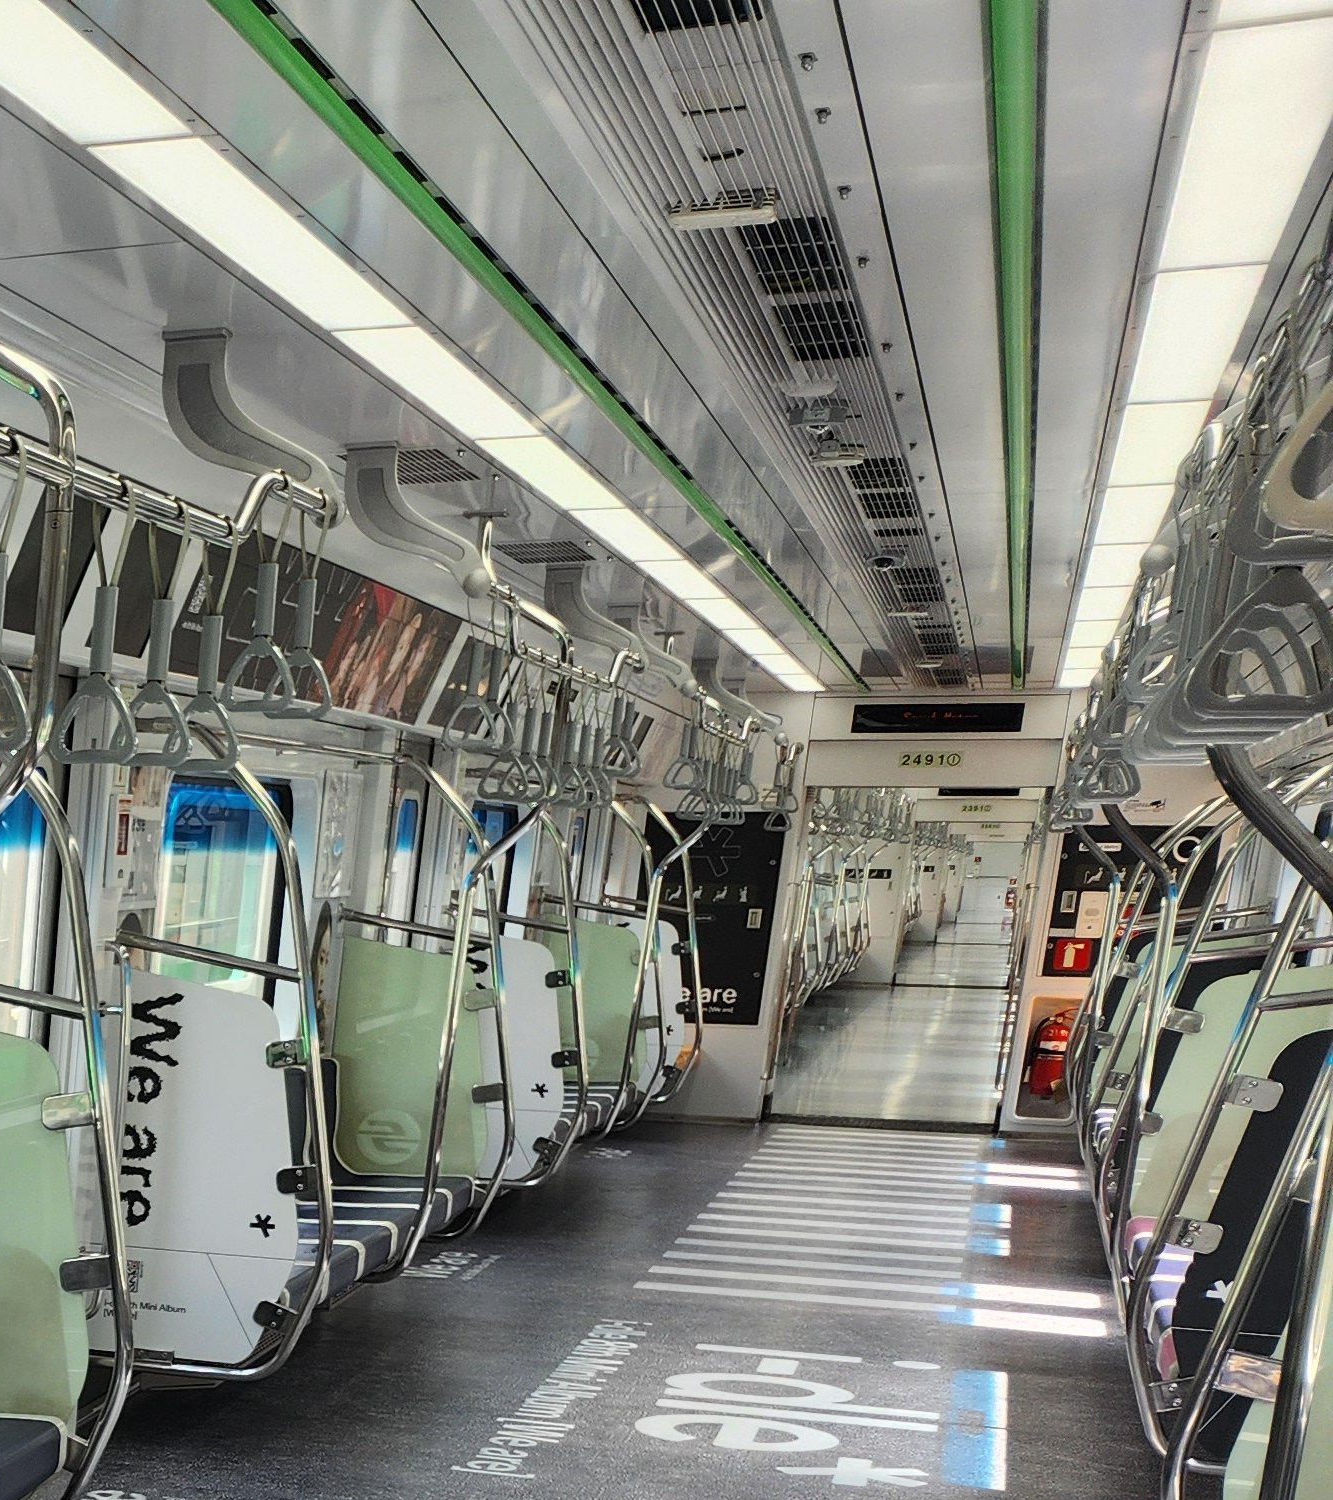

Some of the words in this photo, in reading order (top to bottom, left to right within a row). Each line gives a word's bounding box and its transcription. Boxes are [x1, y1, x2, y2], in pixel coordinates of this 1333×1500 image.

[700, 987, 738, 1004] are
[127, 992, 185, 1105] We
[120, 1124, 158, 1227] are
[139, 1301, 158, 1311] Mini
[159, 1303, 186, 1313] Album
